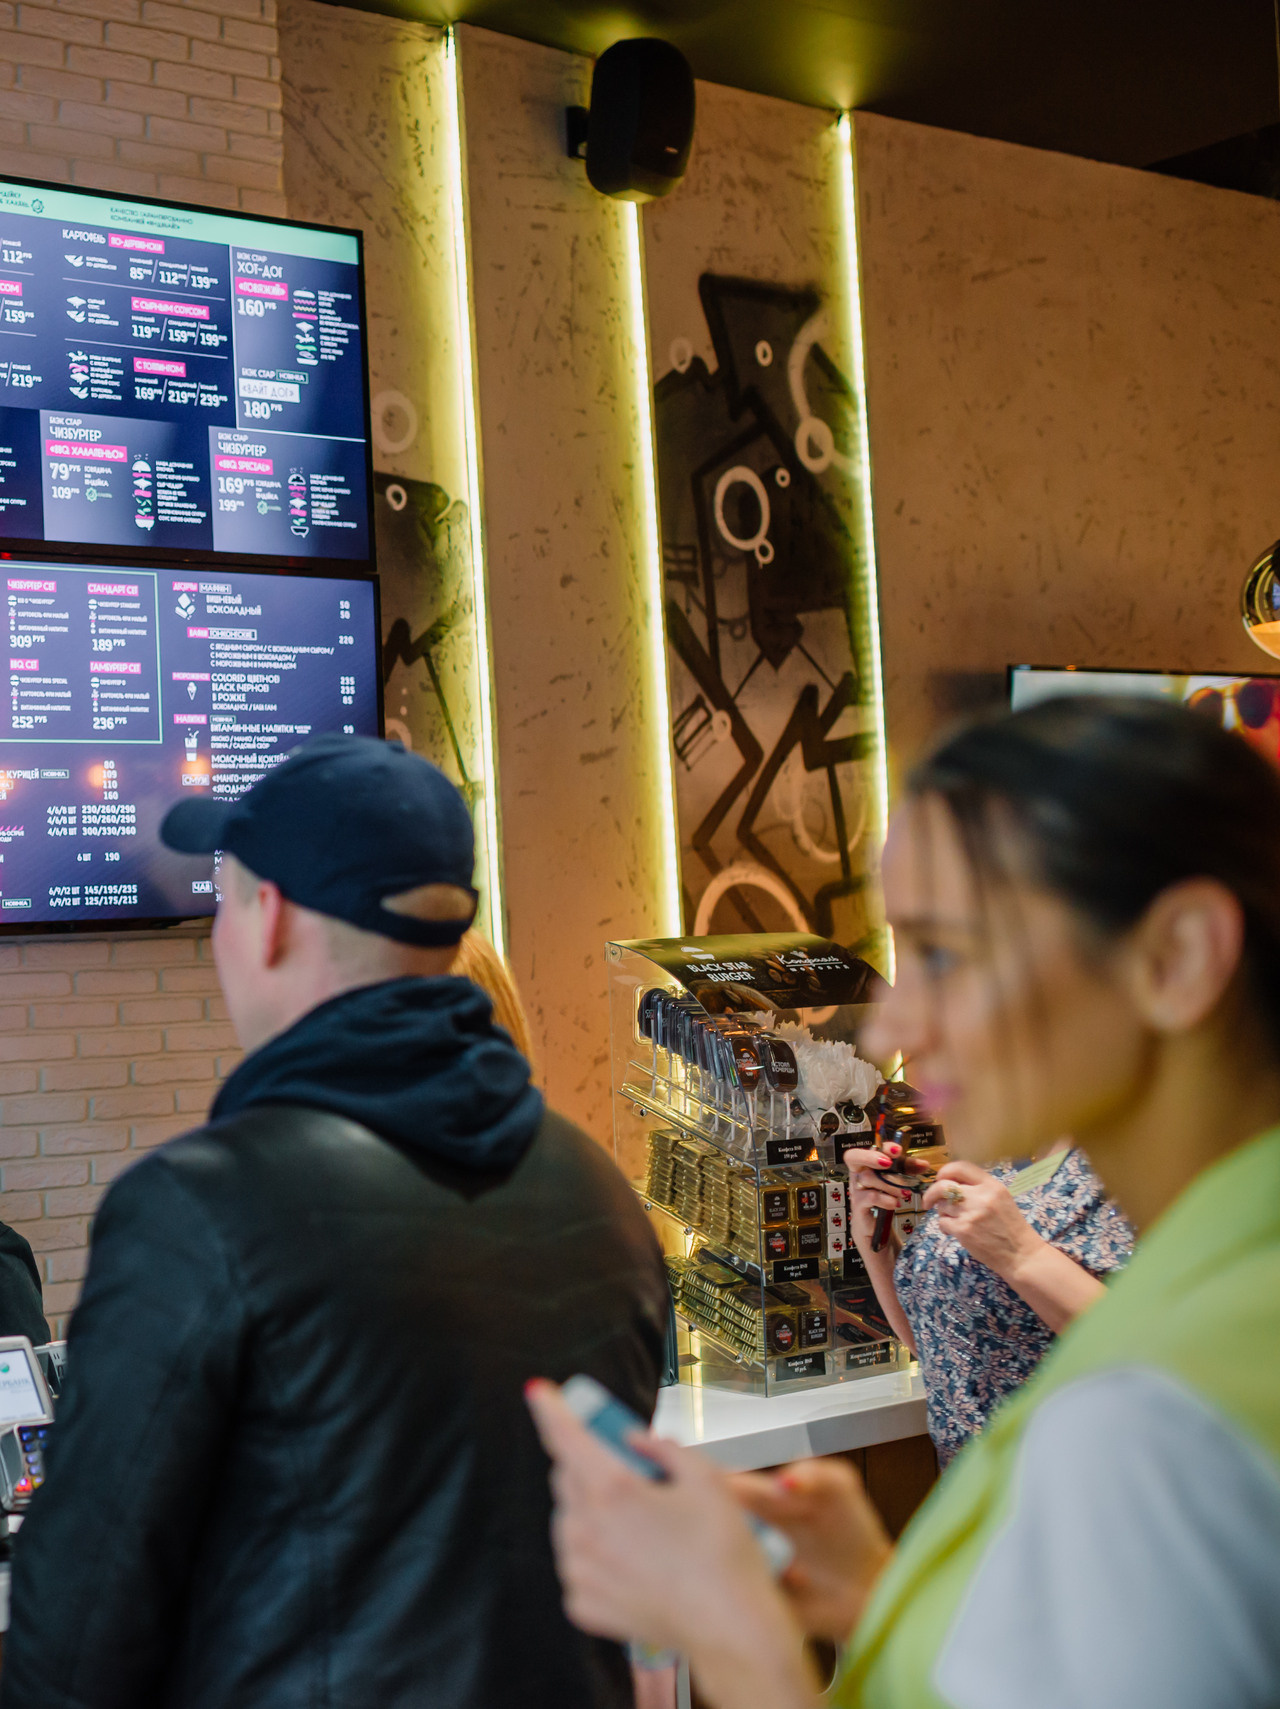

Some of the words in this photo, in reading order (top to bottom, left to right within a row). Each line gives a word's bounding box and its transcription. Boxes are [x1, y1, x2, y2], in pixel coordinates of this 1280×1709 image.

[237, 261, 284, 278] ХОТ-ДОГ
[49, 426, 102, 442] ЧИЗБУРГЕР
[218, 442, 267, 456] ЧИЗБУРГЕР
[686, 962, 725, 973] BLACK
[722, 961, 753, 970] STAR
[706, 971, 755, 983] BURGER
